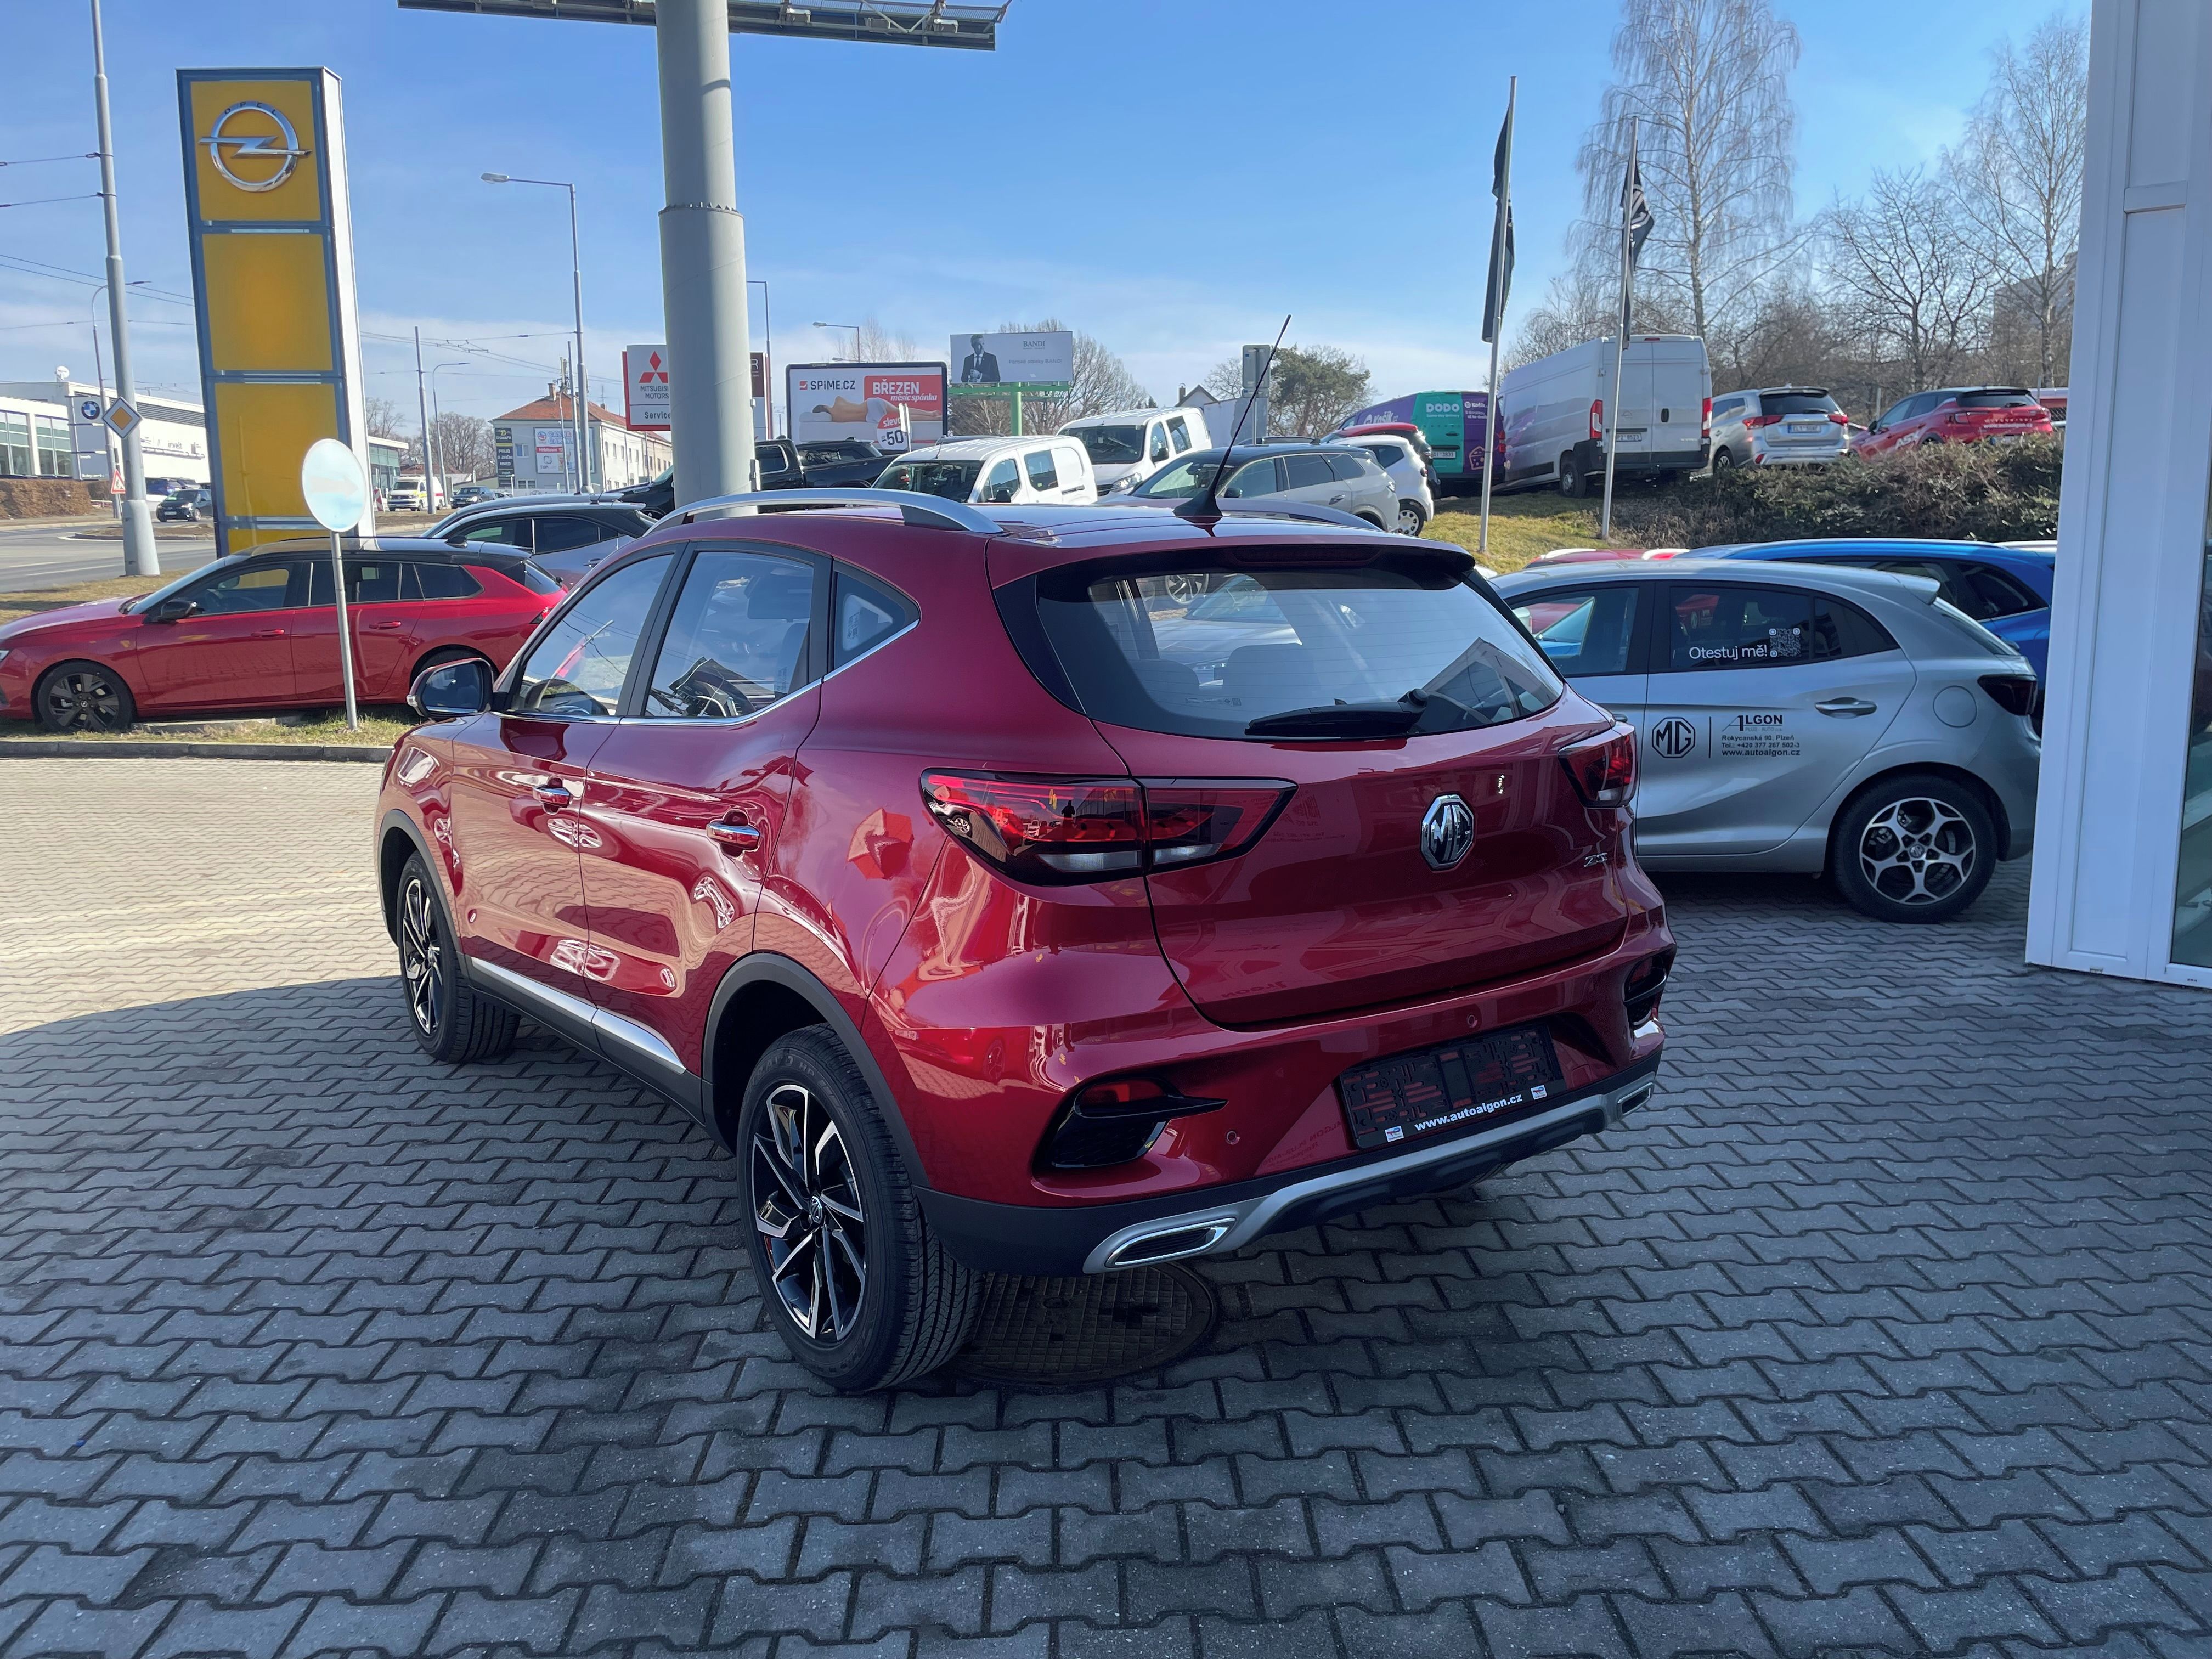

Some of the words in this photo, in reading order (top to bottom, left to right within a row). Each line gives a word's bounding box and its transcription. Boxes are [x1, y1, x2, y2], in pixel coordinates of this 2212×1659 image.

[224, 101, 278, 116] OPEL
[872, 379, 919, 395] BŘEZEN
[890, 393, 911, 402] měsíc
[911, 394, 938, 403] spánku
[1426, 403, 1460, 413] DODO
[1689, 645, 1739, 661] Otestuj
[1741, 644, 1768, 658] mě!
[1656, 721, 1692, 755] MG
[1722, 748, 1801, 757] www.autoalgon.cz
[1584, 852, 1608, 867] ZS
[1414, 1094, 1523, 1131] www.autoalgon.cz
